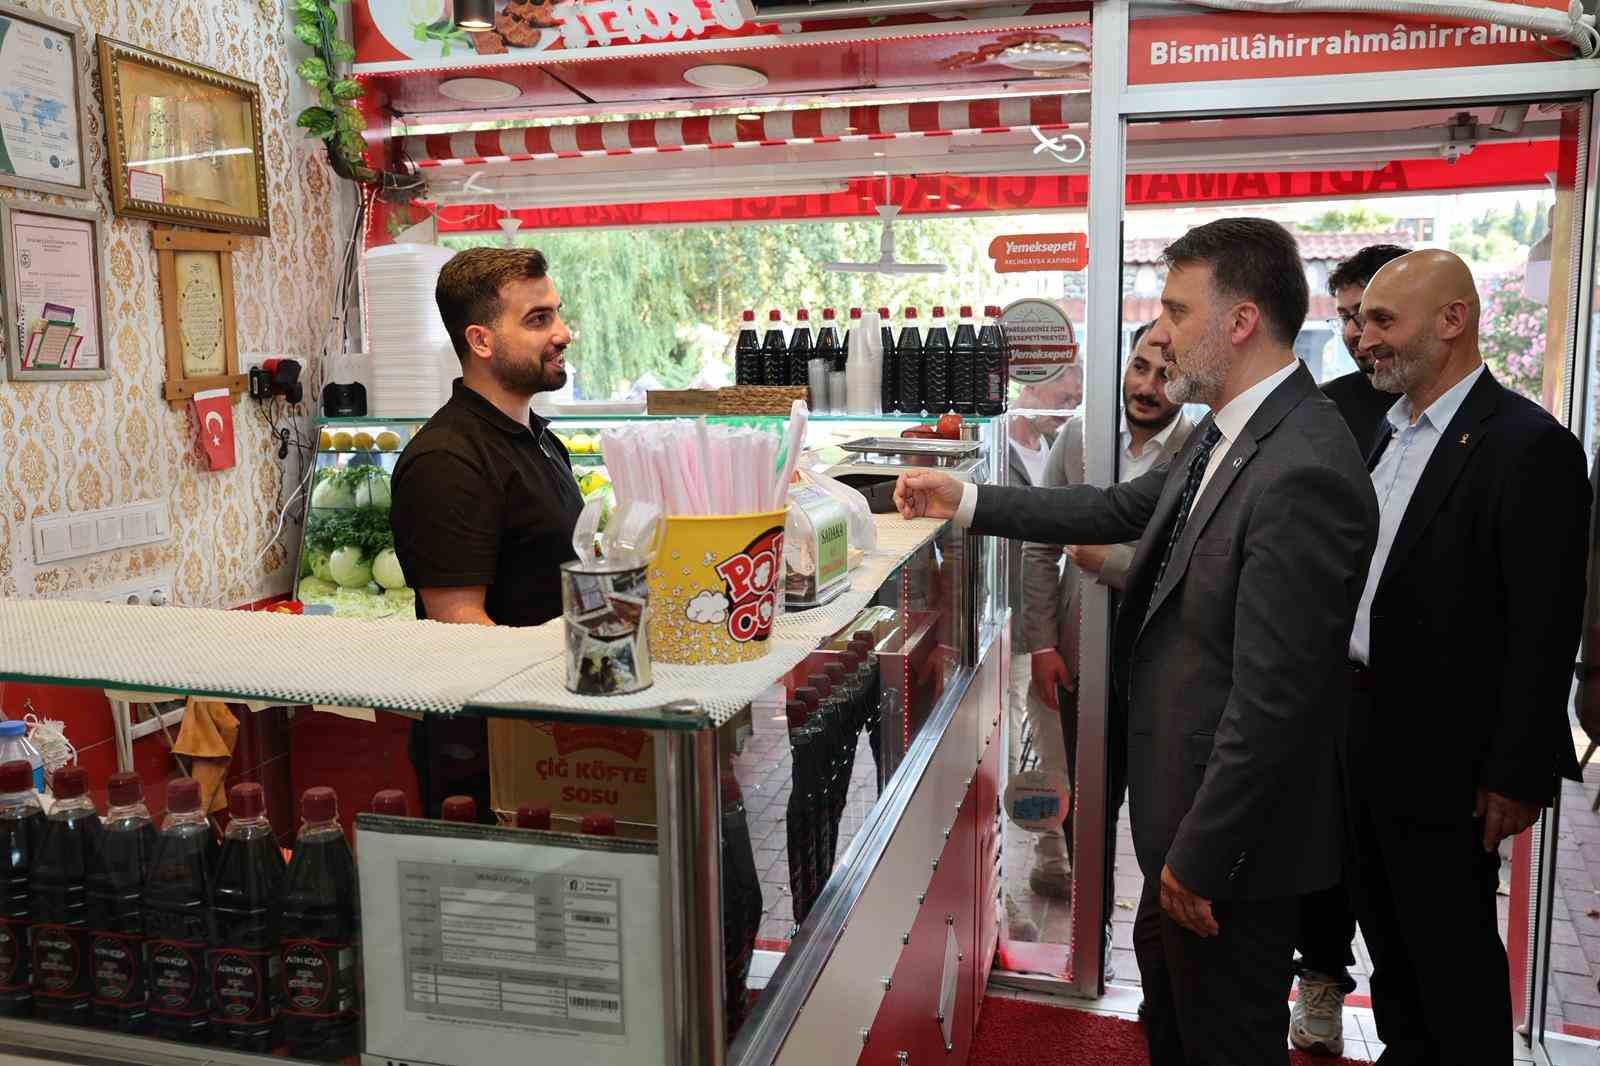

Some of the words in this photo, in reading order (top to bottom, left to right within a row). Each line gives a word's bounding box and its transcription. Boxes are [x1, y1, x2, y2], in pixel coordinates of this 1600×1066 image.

[1005, 240, 1077, 255] Yemeksepeti
[1010, 349, 1072, 361] Yemeksepeti
[535, 756, 569, 783] ÇİĞ
[575, 760, 648, 784] KÖFTE
[561, 785, 619, 805] SOSU
